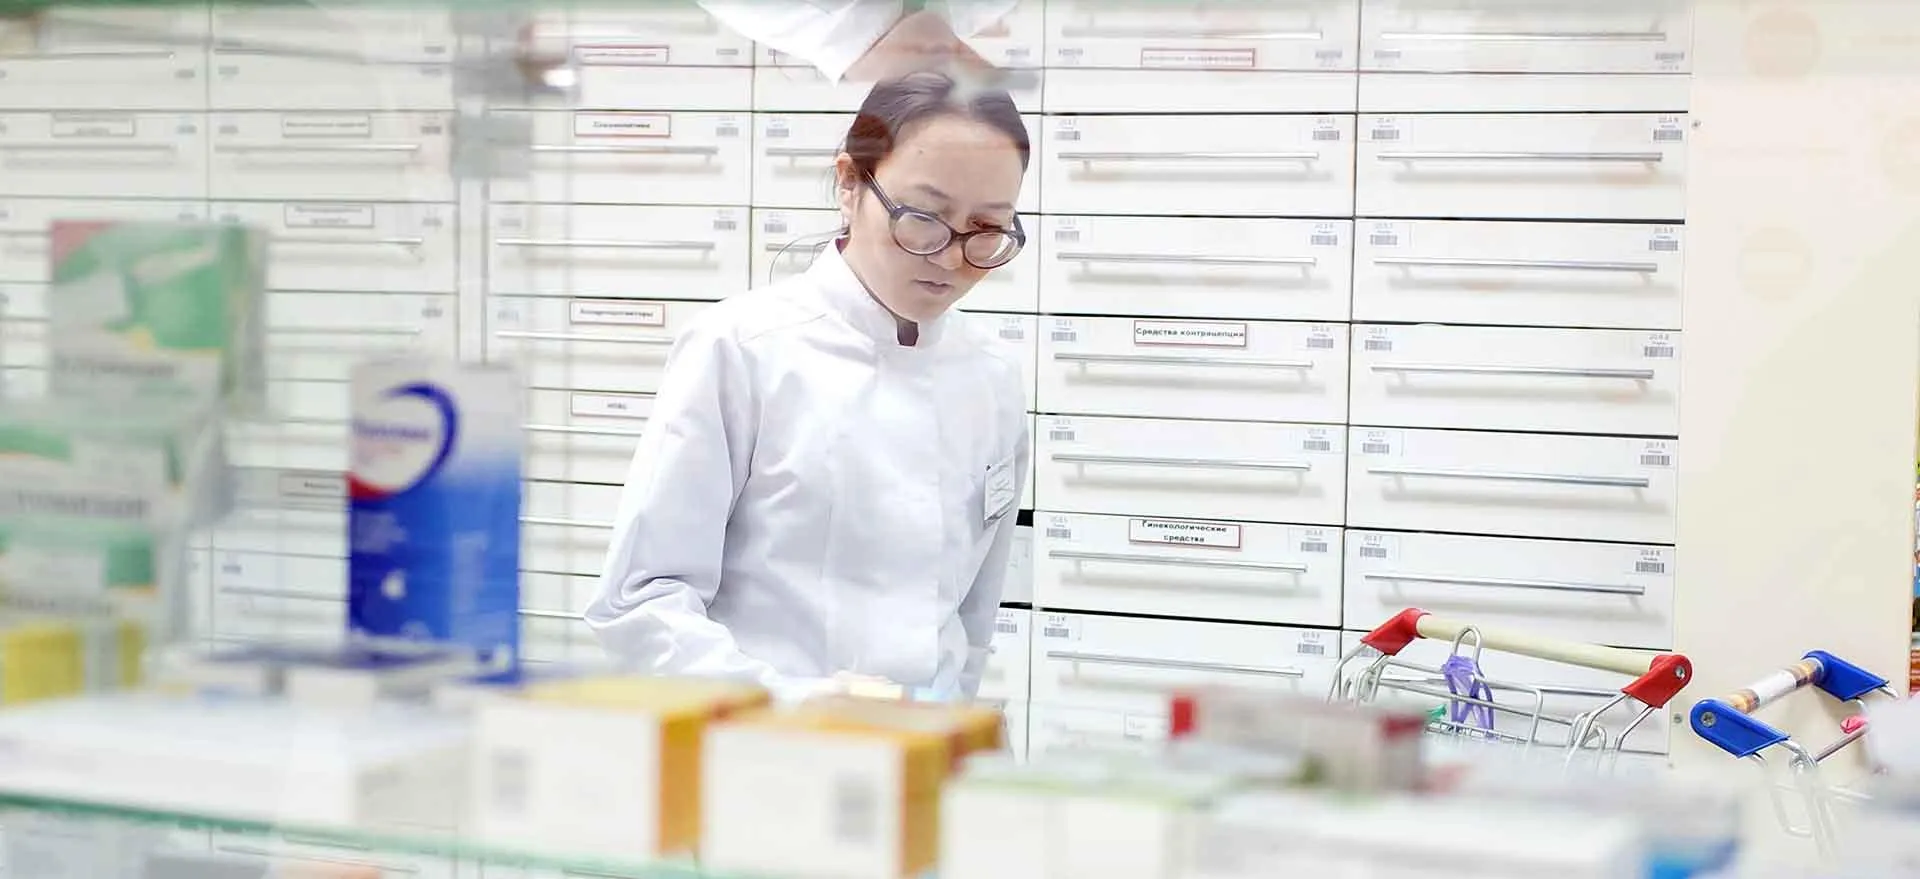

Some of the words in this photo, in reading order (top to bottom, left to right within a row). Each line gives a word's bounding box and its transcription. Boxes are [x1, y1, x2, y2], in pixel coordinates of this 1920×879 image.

[1135, 327, 1178, 337] Средства
[1180, 330, 1245, 339] контрацепции
[1142, 519, 1228, 533] Гинекологические
[1163, 534, 1205, 543] средства
